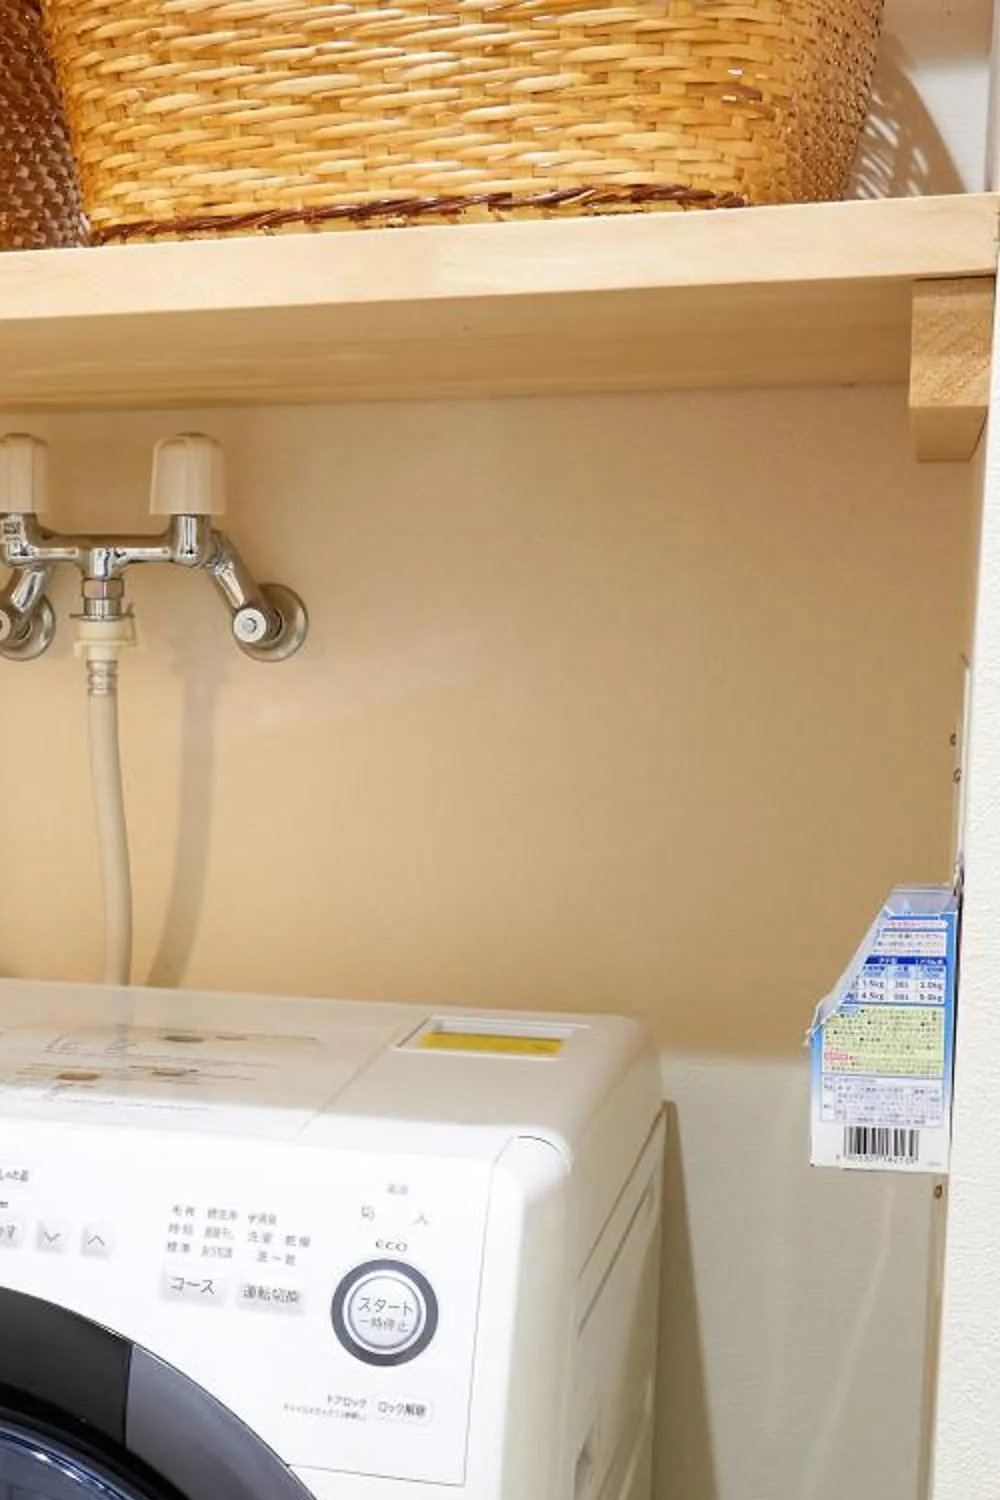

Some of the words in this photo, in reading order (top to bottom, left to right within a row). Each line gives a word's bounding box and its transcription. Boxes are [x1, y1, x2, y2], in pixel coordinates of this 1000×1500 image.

[169, 1276, 215, 1296] コース
[357, 1296, 414, 1317] スタート
[359, 1316, 410, 1334] 一時停止
